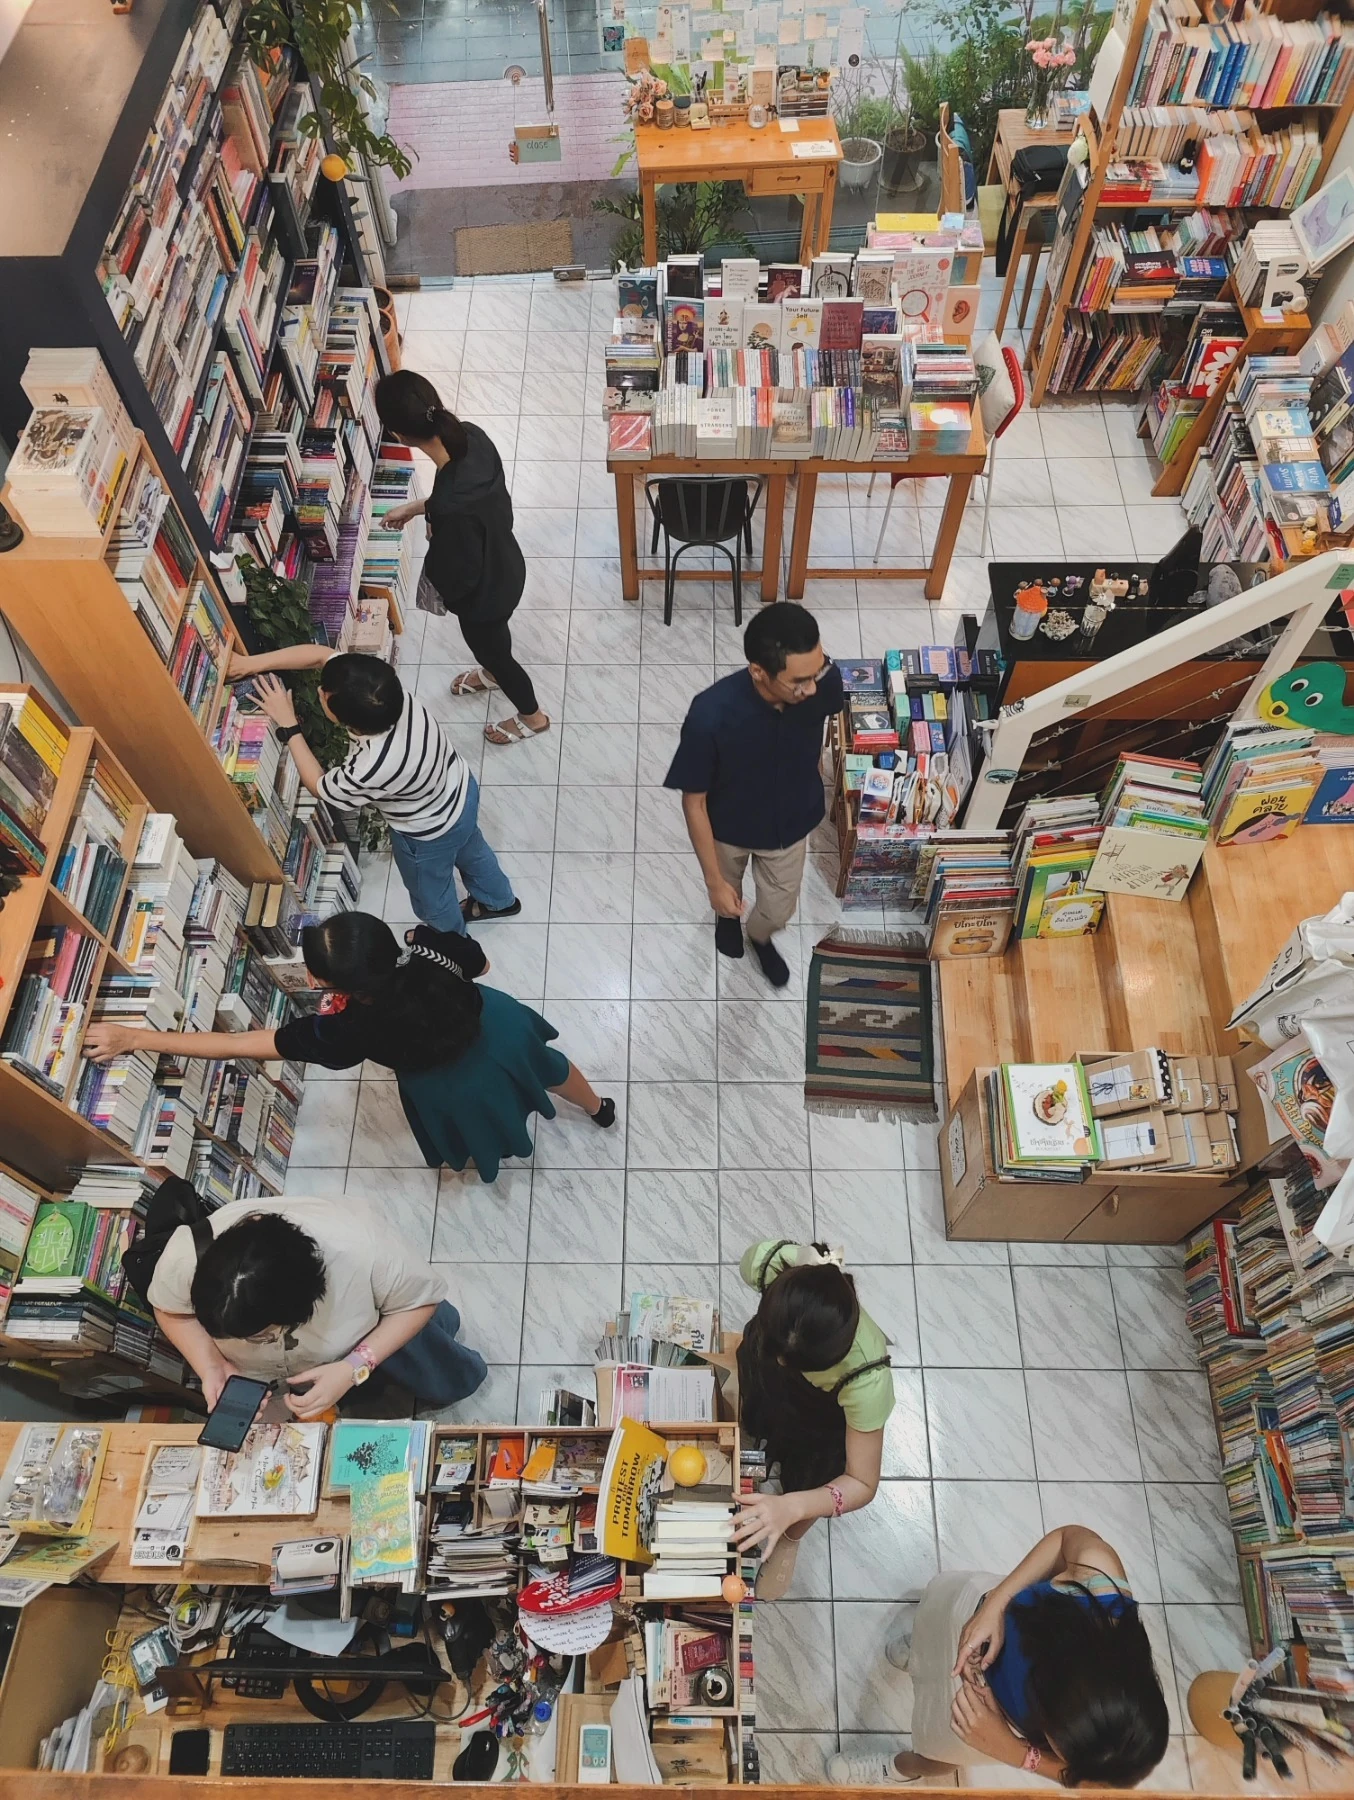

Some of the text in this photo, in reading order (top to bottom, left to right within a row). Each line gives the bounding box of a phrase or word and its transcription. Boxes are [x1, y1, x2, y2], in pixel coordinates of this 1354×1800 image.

[526, 140, 549, 150] close
[786, 306, 799, 314] Your
[1279, 468, 1294, 488] Swim
[1307, 467, 1321, 486] Why
[1261, 795, 1287, 806] ผ่อน
[1252, 803, 1289, 814] คลาย
[613, 1459, 628, 1525] PROTEST
[622, 1452, 641, 1538] TOMORROW
[133, 1550, 166, 1560] STICKER
